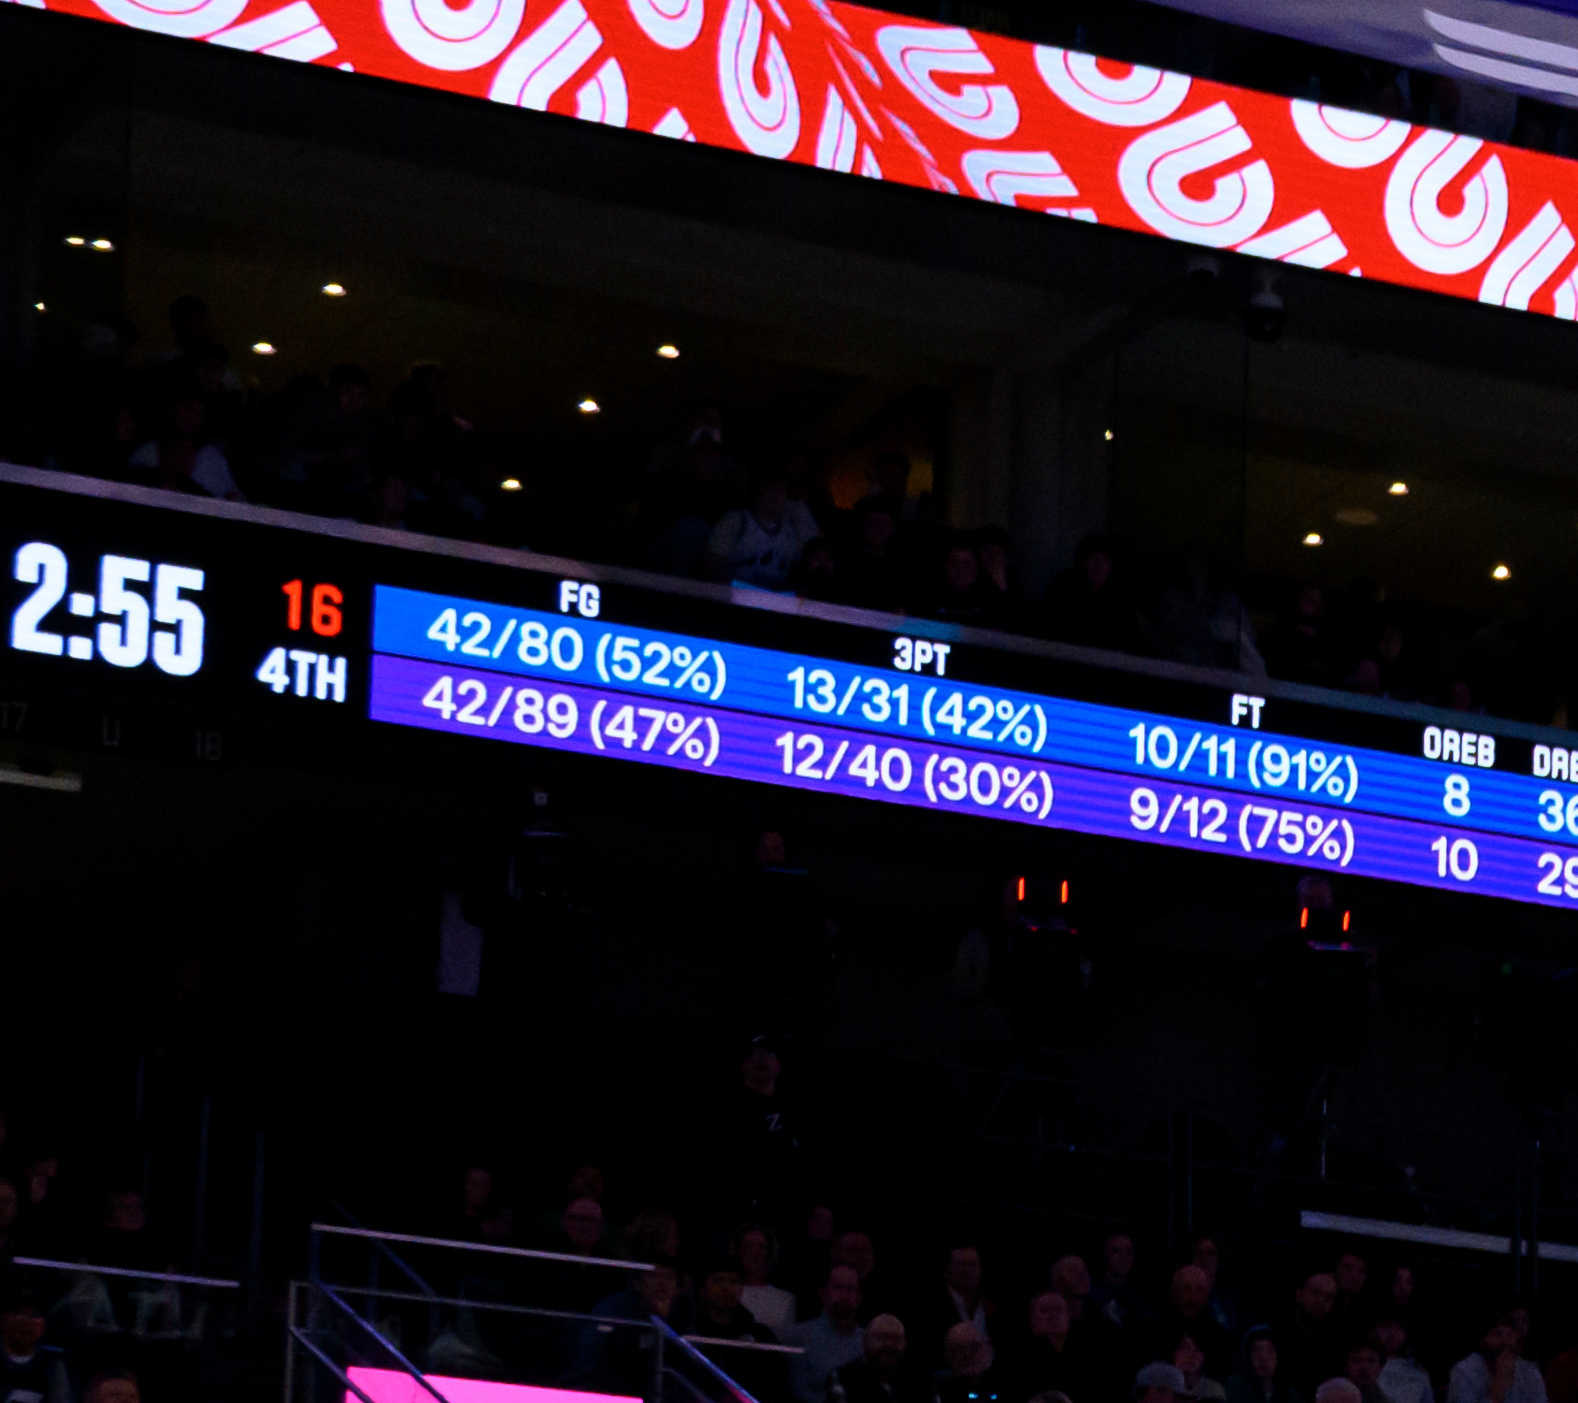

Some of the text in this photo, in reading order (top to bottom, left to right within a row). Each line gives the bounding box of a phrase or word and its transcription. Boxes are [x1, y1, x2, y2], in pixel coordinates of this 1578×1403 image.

[12, 542, 204, 676] 2:55
[257, 646, 347, 703] 4TH
[282, 579, 344, 637] 16
[560, 580, 600, 618] FG
[893, 637, 951, 676] 3PT
[1231, 693, 1265, 729] FT
[1423, 725, 1496, 768] OREB
[421, 675, 579, 739] 42/89
[589, 699, 720, 767] (47%)
[775, 731, 913, 792] 12/40
[923, 753, 1054, 820] (30%)
[1129, 787, 1228, 843] 9/12
[1238, 803, 1355, 867] (75%)
[1431, 835, 1479, 882] 10
[427, 608, 584, 671] 42/80
[596, 633, 727, 701] (52%)
[787, 666, 909, 726] 13/31
[922, 687, 1047, 753] (42%)
[1129, 722, 1236, 779] 10/11
[1248, 741, 1359, 803] (91%)
[1443, 773, 1471, 817] 8
